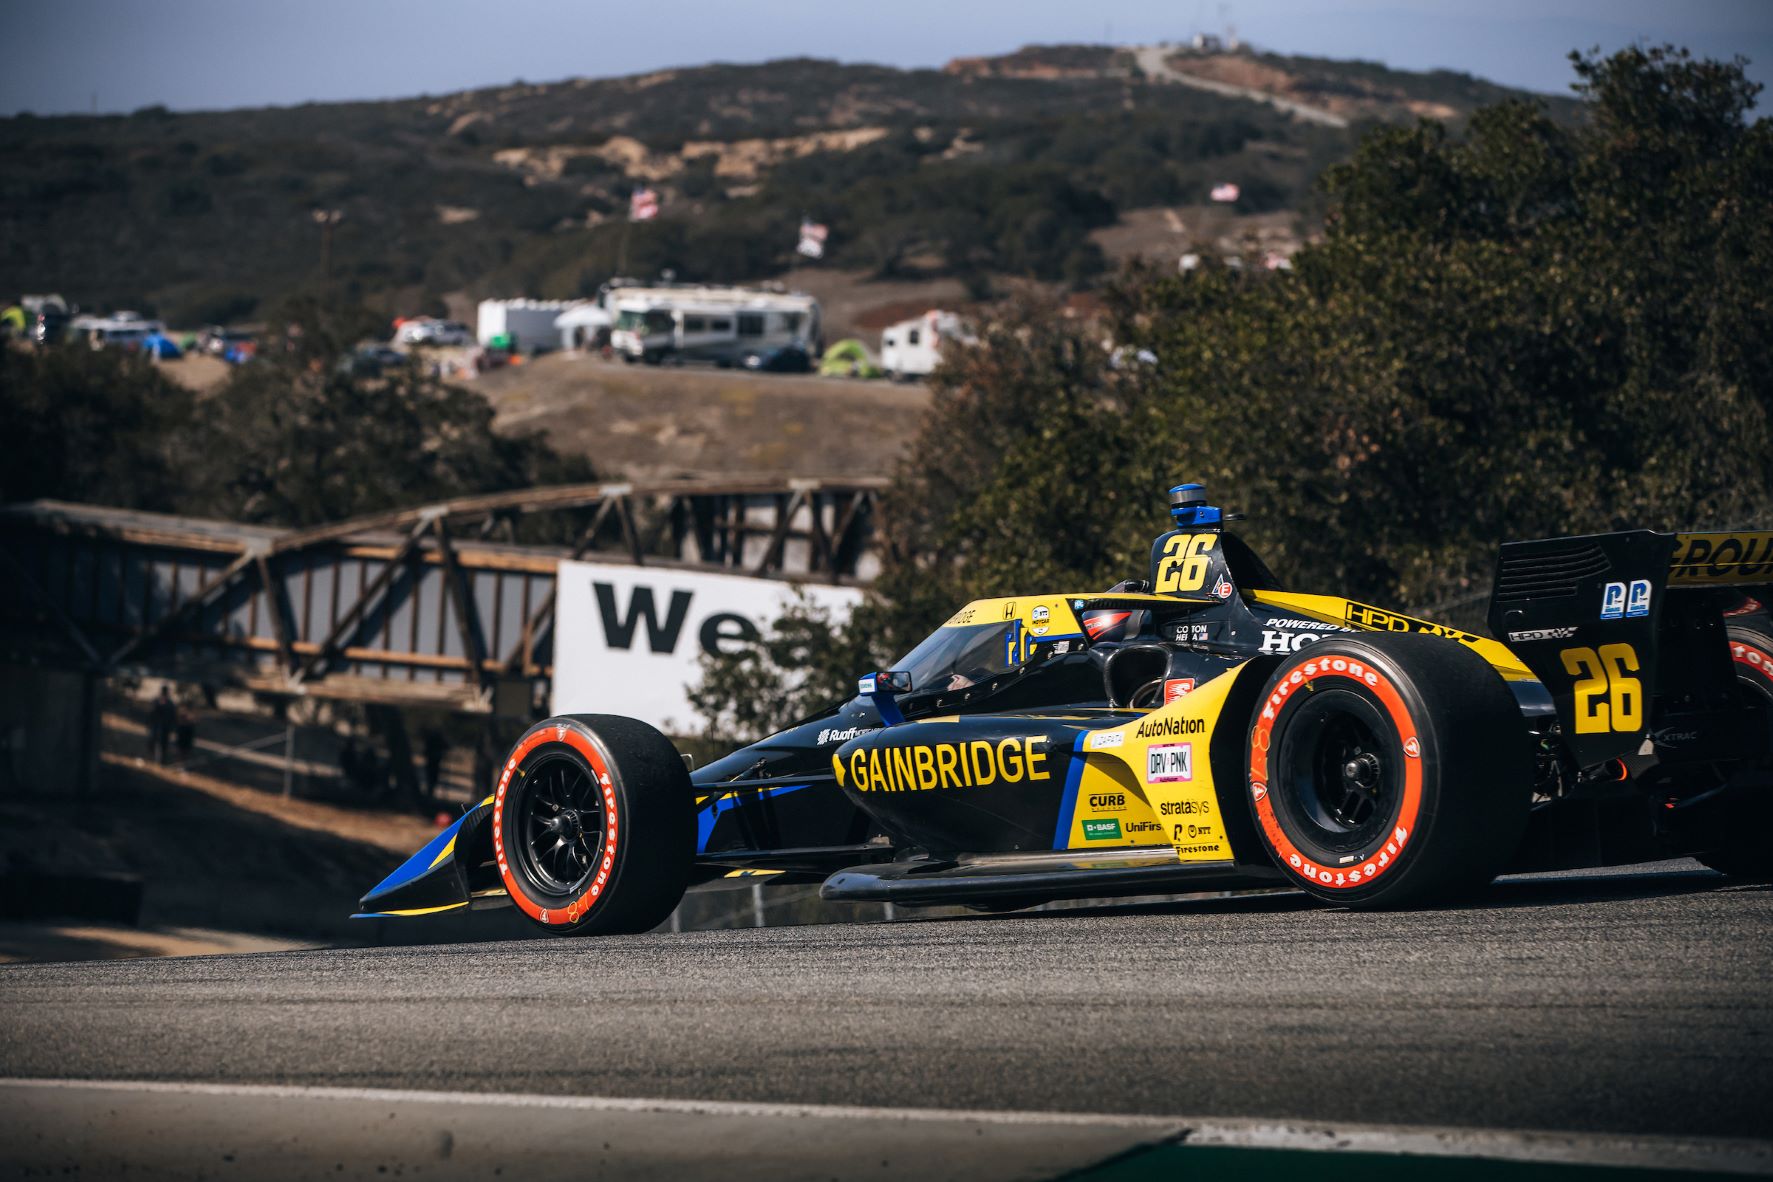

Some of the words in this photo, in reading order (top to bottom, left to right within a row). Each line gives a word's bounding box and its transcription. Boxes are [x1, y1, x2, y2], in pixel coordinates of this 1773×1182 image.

[1155, 533, 1218, 593] 26
[1265, 618, 1341, 632] POWERED
[1346, 603, 1410, 633] HPD
[1176, 624, 1208, 634] COTON
[1510, 631, 1544, 641] HPD
[1262, 657, 1378, 720] Firestone
[1559, 642, 1643, 735] 26
[829, 726, 857, 742] Ruoff
[1135, 715, 1206, 739] AutoNation
[850, 735, 1051, 792] GAINBRIDGE
[1150, 752, 1167, 774] DRV
[1170, 751, 1188, 773] PNK
[1089, 794, 1126, 808] CURB
[1160, 799, 1210, 817] stratasys
[494, 758, 517, 876] Firestone
[1096, 823, 1116, 831] BASF
[1125, 820, 1163, 833] UniFirs
[591, 772, 616, 896] Firestone
[1197, 826, 1212, 835] NTT
[1176, 844, 1220, 856] Firestone
[1289, 826, 1408, 887] Firestone
